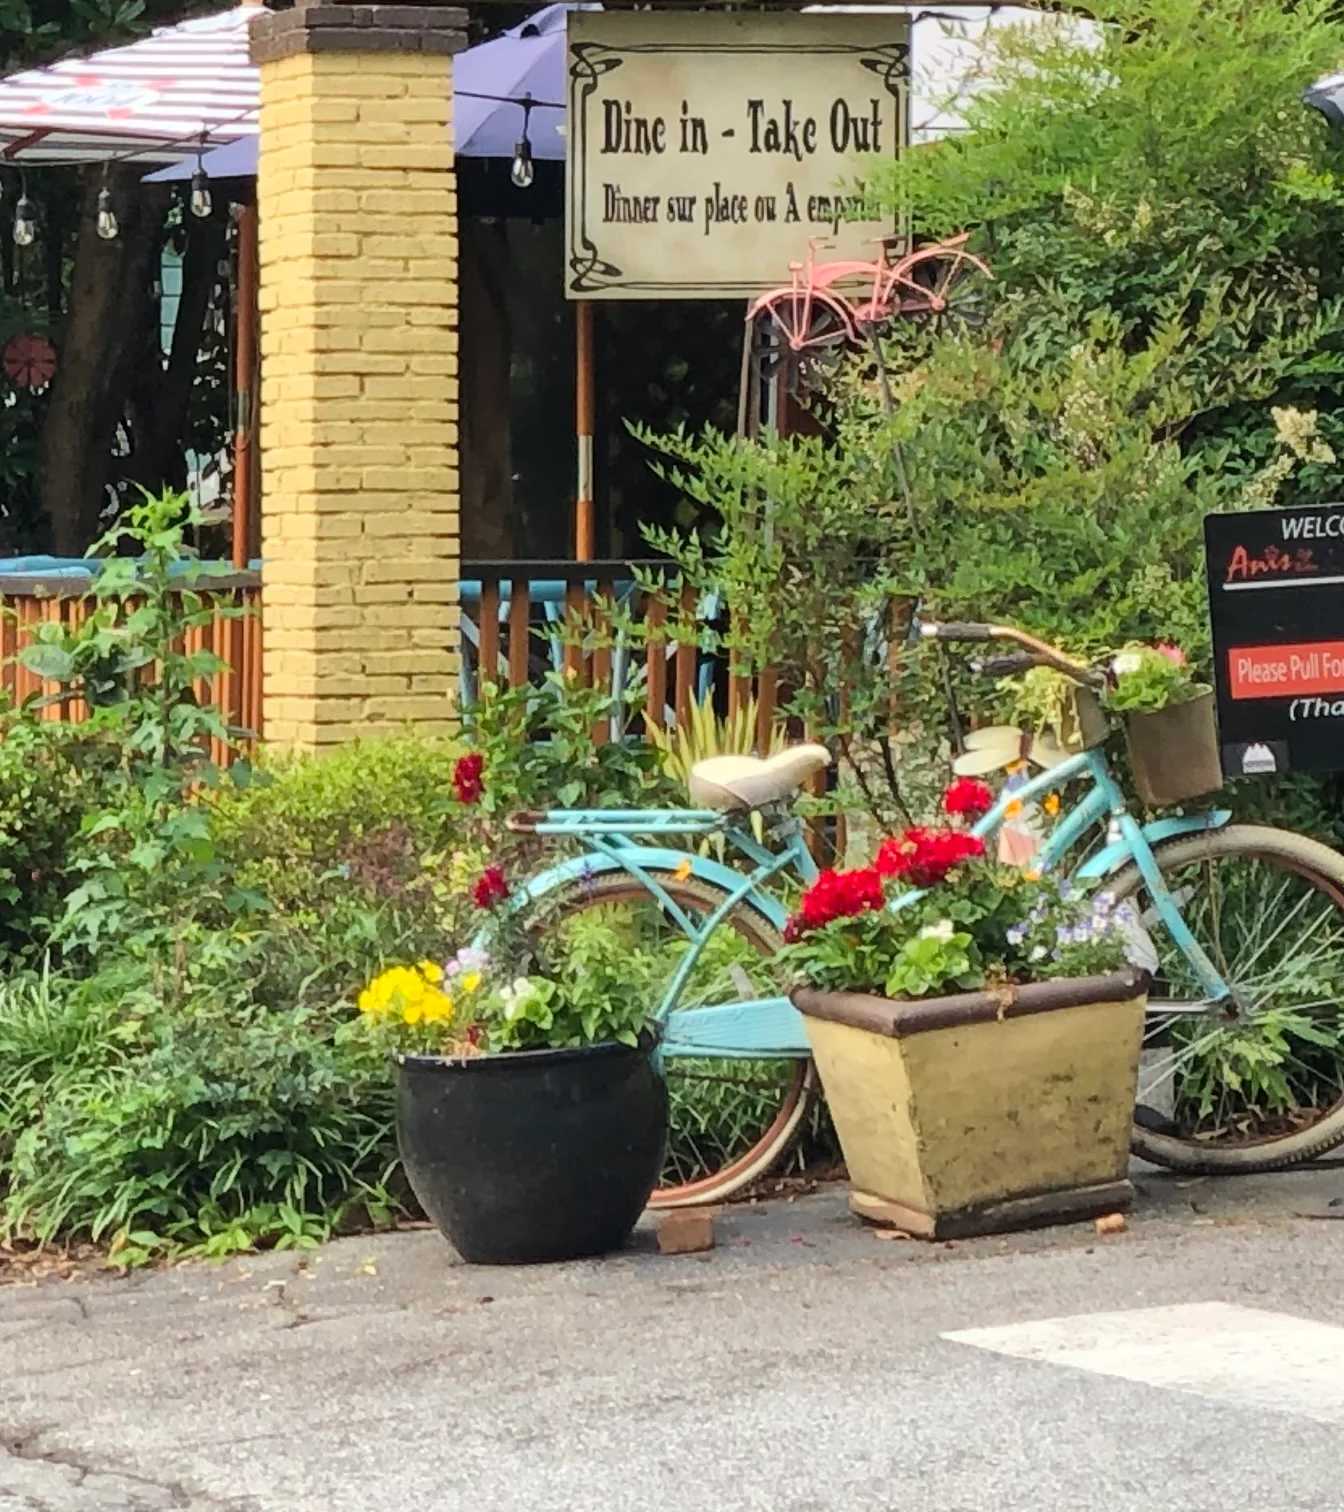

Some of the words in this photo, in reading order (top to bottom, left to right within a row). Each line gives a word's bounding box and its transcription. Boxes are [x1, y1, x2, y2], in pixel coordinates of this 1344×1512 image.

[600, 99, 666, 156] Dine
[679, 99, 709, 155] in
[747, 99, 818, 161] Take
[829, 98, 883, 153] Out
[666, 192, 697, 223] sur
[704, 182, 748, 235] place
[754, 197, 777, 223] ou
[1226, 544, 1293, 583] Anis
[1238, 657, 1288, 684] Please
[1291, 654, 1319, 680] Pull
